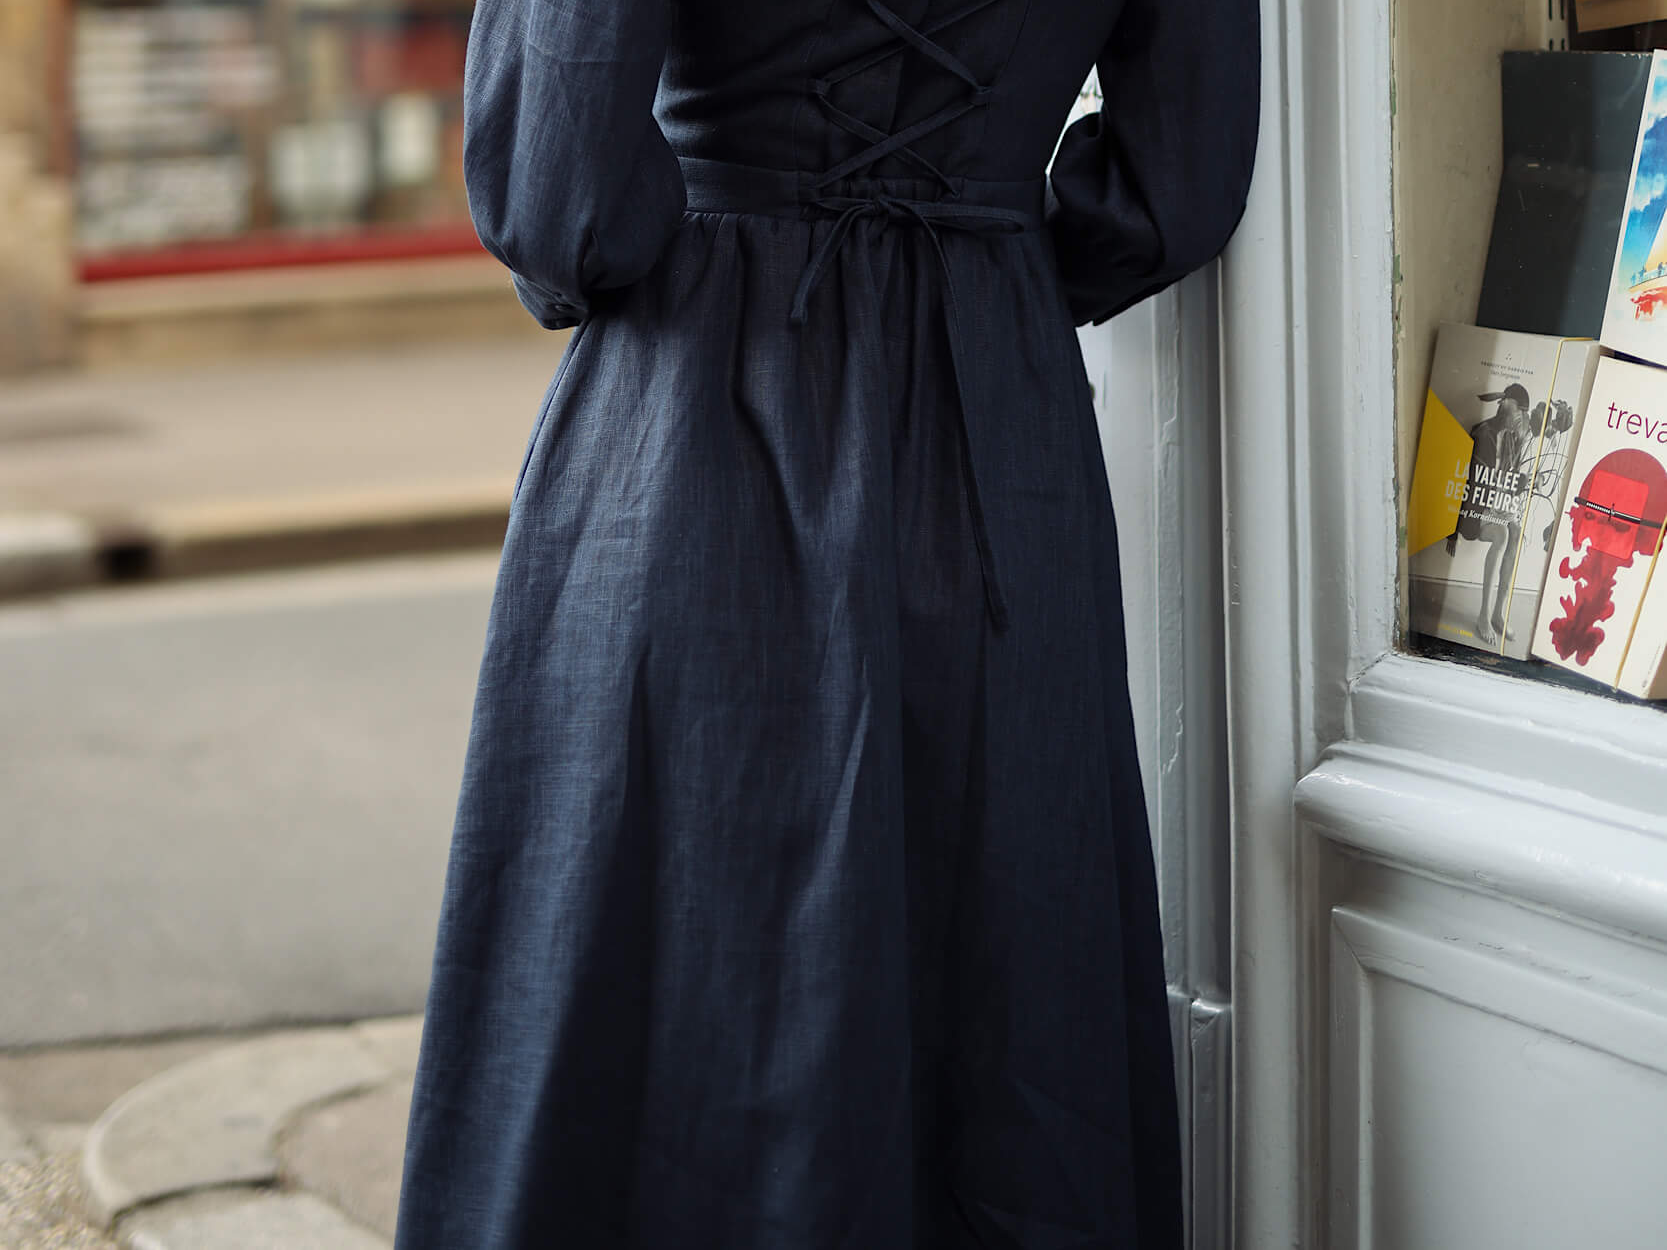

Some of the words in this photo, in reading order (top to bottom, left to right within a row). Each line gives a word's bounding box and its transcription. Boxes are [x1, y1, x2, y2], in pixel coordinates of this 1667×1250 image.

[1454, 458, 1470, 480] LA
[1474, 463, 1521, 492] VALLÉE
[1445, 480, 1471, 502] DES
[1471, 486, 1521, 513] FLEURS
